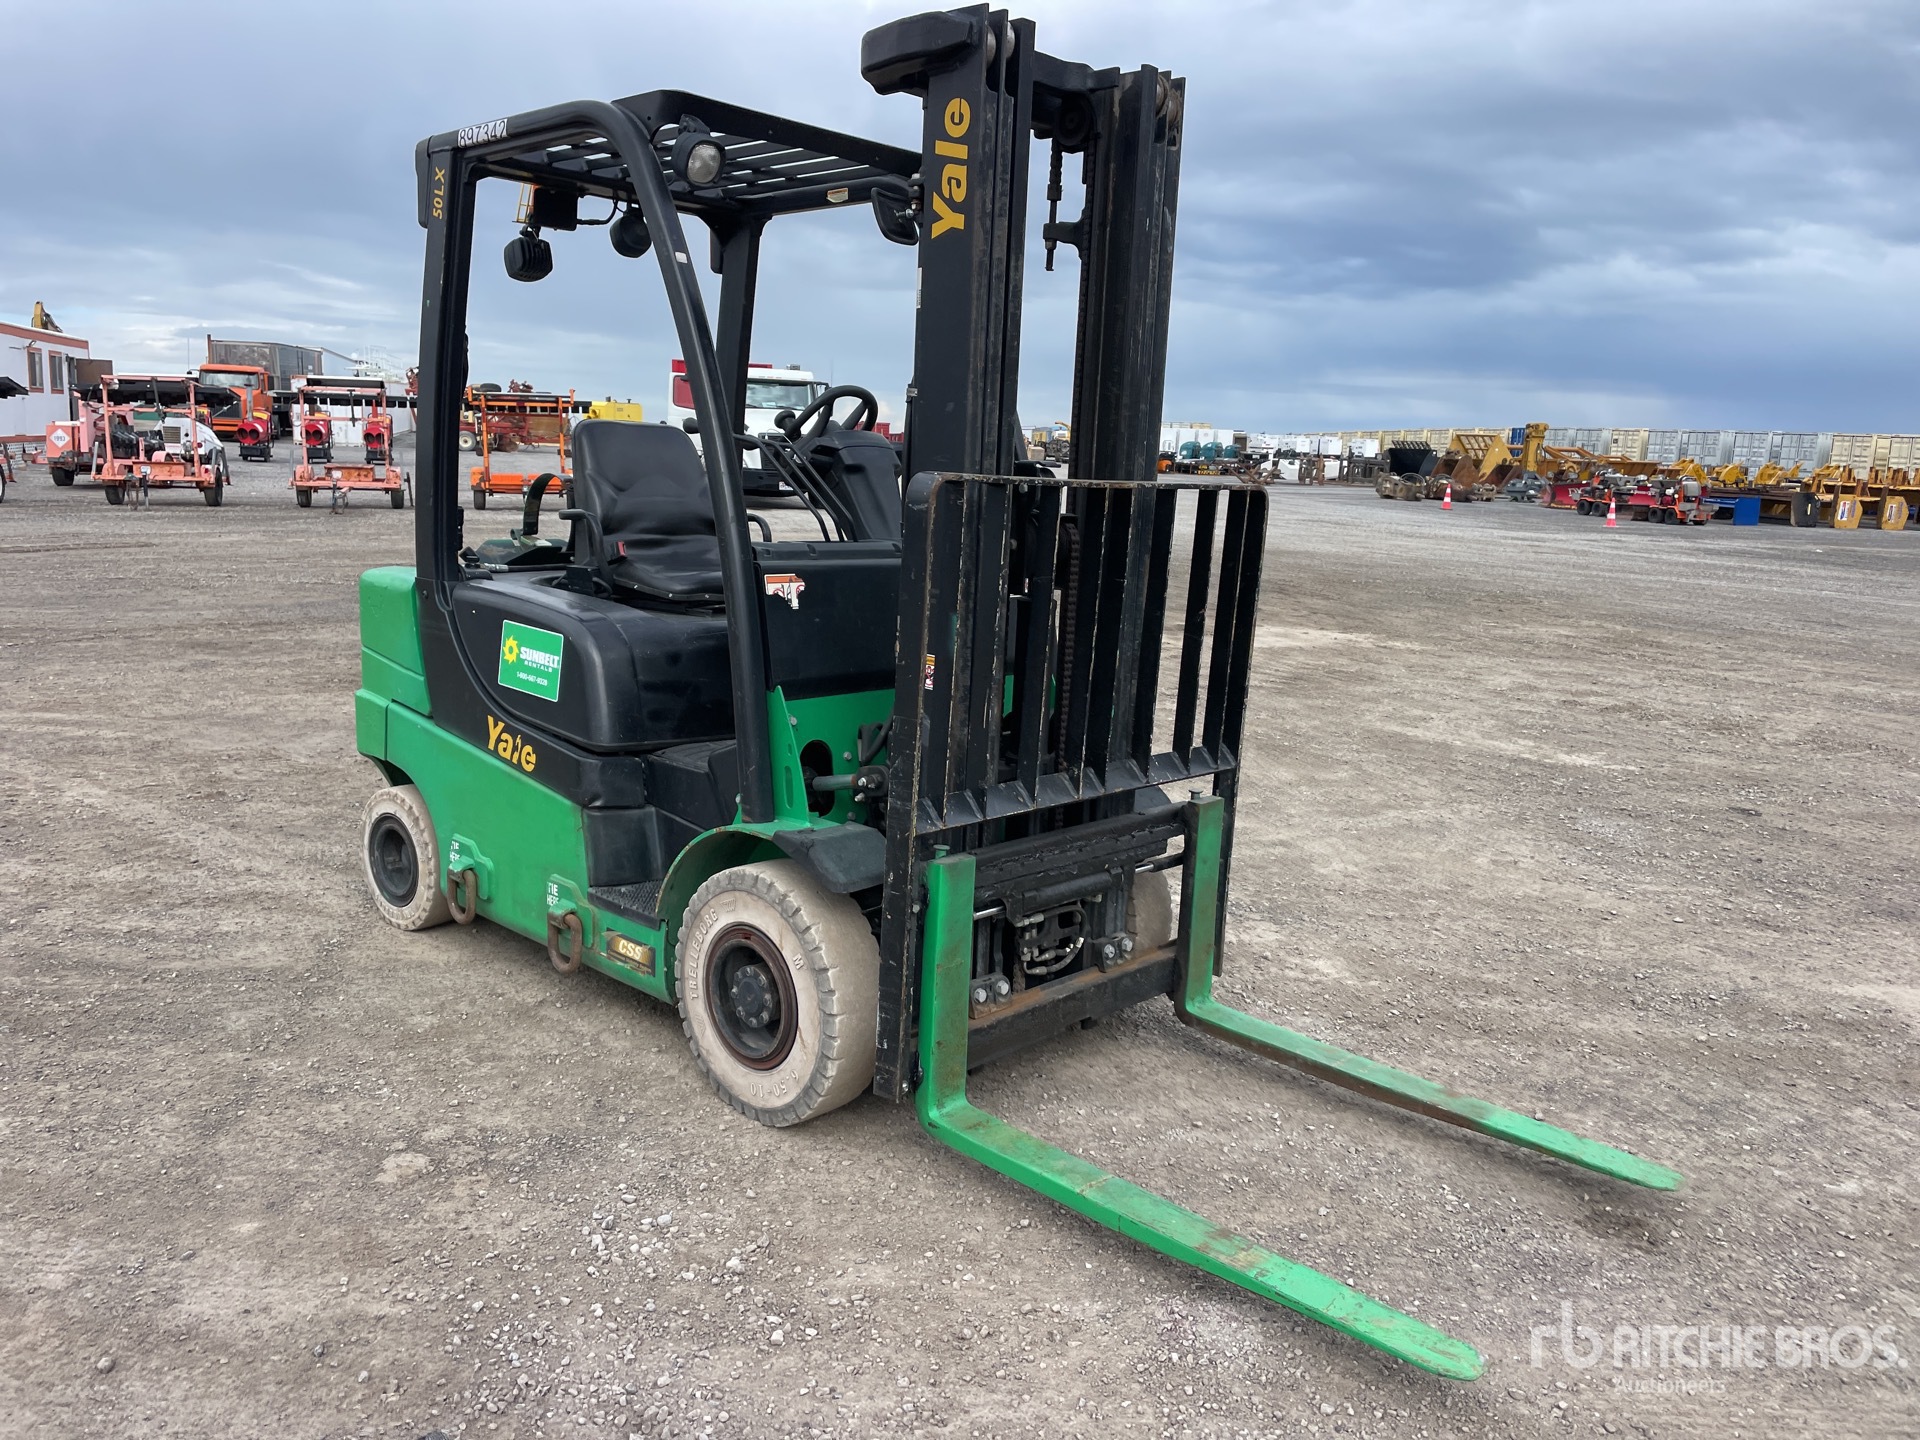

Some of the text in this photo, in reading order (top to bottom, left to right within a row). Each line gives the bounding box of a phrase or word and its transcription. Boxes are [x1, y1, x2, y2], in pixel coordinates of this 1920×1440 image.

[459, 119, 506, 148] 897342
[931, 97, 971, 239] Yale
[520, 646, 559, 668] SUNBELT
[524, 660, 553, 673] RENTALS
[487, 715, 536, 772] Yale
[546, 881, 559, 896] TIE
[688, 908, 719, 1000] TRELLEBORG
